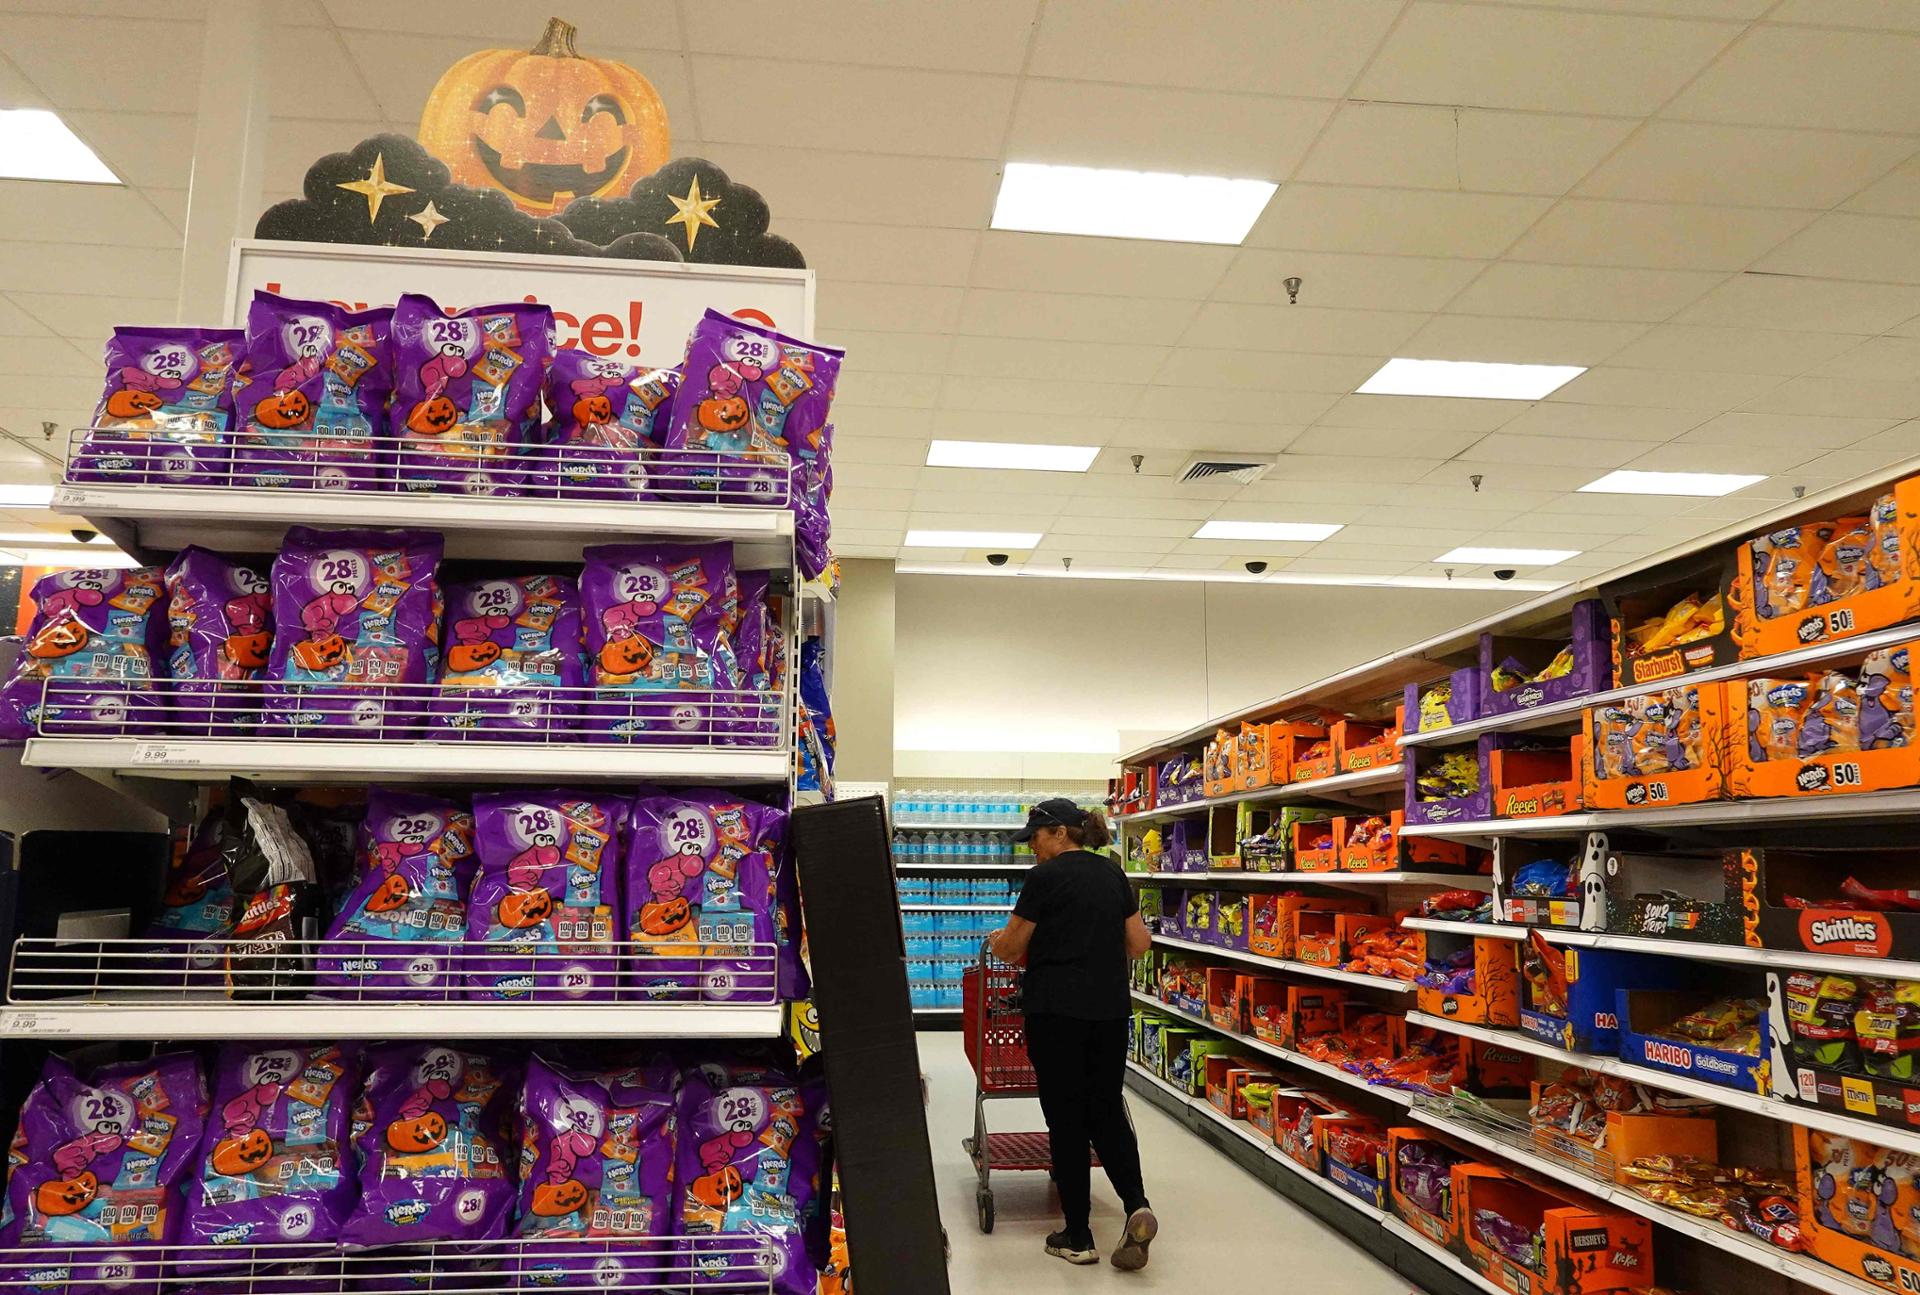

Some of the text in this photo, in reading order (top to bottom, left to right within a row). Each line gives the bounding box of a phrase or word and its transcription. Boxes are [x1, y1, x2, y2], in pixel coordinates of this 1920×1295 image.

[433, 321, 463, 342] 28
[737, 342, 763, 357] 28
[154, 352, 180, 370] 28
[340, 349, 368, 368] Nerds
[488, 351, 514, 368] Nerds
[592, 362, 618, 372] 28
[782, 368, 804, 389] Nerds
[629, 405, 651, 418] Nerds
[762, 401, 786, 416] Nerds
[168, 460, 185, 471] 28
[754, 481, 768, 492] 28
[70, 570, 98, 581] 28
[322, 560, 352, 582] 28
[672, 565, 698, 579] Nerds
[128, 586, 155, 597] Nerds
[379, 586, 401, 596] Nerds
[624, 575, 653, 594] 28
[479, 590, 506, 609] 28
[677, 592, 702, 603] Nerds
[112, 615, 142, 625] Nerds
[363, 617, 389, 630] Nerds
[1830, 610, 1850, 632] 50
[1799, 618, 1825, 639] Nerds
[94, 654, 108, 663] 100
[386, 662, 400, 670] 100
[662, 664, 674, 673] 100
[1634, 654, 1683, 680] Starburst
[1768, 686, 1802, 701] Nerds
[1349, 754, 1372, 769] Reese's
[1799, 768, 1826, 788] Nerds
[1834, 764, 1854, 785] 50
[1626, 785, 1646, 800] Nerds
[1650, 782, 1664, 800] 50
[1506, 795, 1538, 816] Reese's
[520, 810, 550, 836] 28
[716, 810, 742, 826] Nerds
[398, 820, 428, 836] 28
[672, 818, 700, 842] 28
[444, 831, 466, 854] Nerds
[576, 835, 600, 847] Nerds
[1347, 854, 1369, 869] Reese's
[570, 873, 597, 885] Nerds
[707, 879, 734, 892] Nerds
[241, 898, 281, 923] kittles
[414, 911, 426, 921] 100
[1644, 903, 1670, 919] SOUR
[432, 914, 444, 924] 100
[448, 916, 461, 926] 100
[560, 922, 572, 931] 100
[576, 922, 588, 931] 100
[593, 922, 605, 931] 100
[1642, 919, 1667, 934] STRIPS
[701, 926, 711, 936] 100
[717, 926, 730, 936] 100
[735, 924, 748, 934] 100
[1812, 919, 1877, 944] Skittles
[342, 960, 379, 972] Nerds
[497, 976, 532, 990] Nerds
[567, 975, 584, 986] 28
[711, 976, 727, 988] 28
[1645, 1041, 1739, 1075] HARIBO Goldbears
[255, 1058, 285, 1075] 28
[303, 1068, 334, 1080] Nerds
[1800, 1072, 1814, 1087] 120
[771, 1088, 796, 1102] Nerds
[88, 1098, 117, 1120] 28
[292, 1107, 322, 1123] Nerds
[723, 1097, 751, 1122] 28
[608, 1115, 633, 1131] Nerds
[472, 1146, 484, 1156] 100
[126, 1157, 158, 1170] Nerds
[281, 1162, 294, 1172] 100
[318, 1159, 332, 1169] 100
[763, 1159, 788, 1170] Nerds
[606, 1164, 634, 1179] Nerds
[102, 1207, 116, 1218] 100
[122, 1206, 137, 1216] 100
[142, 1206, 158, 1216] 100
[387, 1203, 426, 1219] Nerds
[462, 1198, 477, 1213] 28
[286, 1213, 303, 1230] 28
[595, 1212, 606, 1222] 100
[612, 1212, 626, 1222] 100
[631, 1213, 644, 1222] 100
[212, 1225, 250, 1245] Nerds
[1574, 1232, 1606, 1248] HERSHEY'S
[105, 1264, 122, 1278] 28
[1864, 1257, 1892, 1274] Nerds
[30, 1268, 68, 1282] Nerds
[1518, 1271, 1530, 1292] 110
[1901, 1269, 1920, 1292] 50
